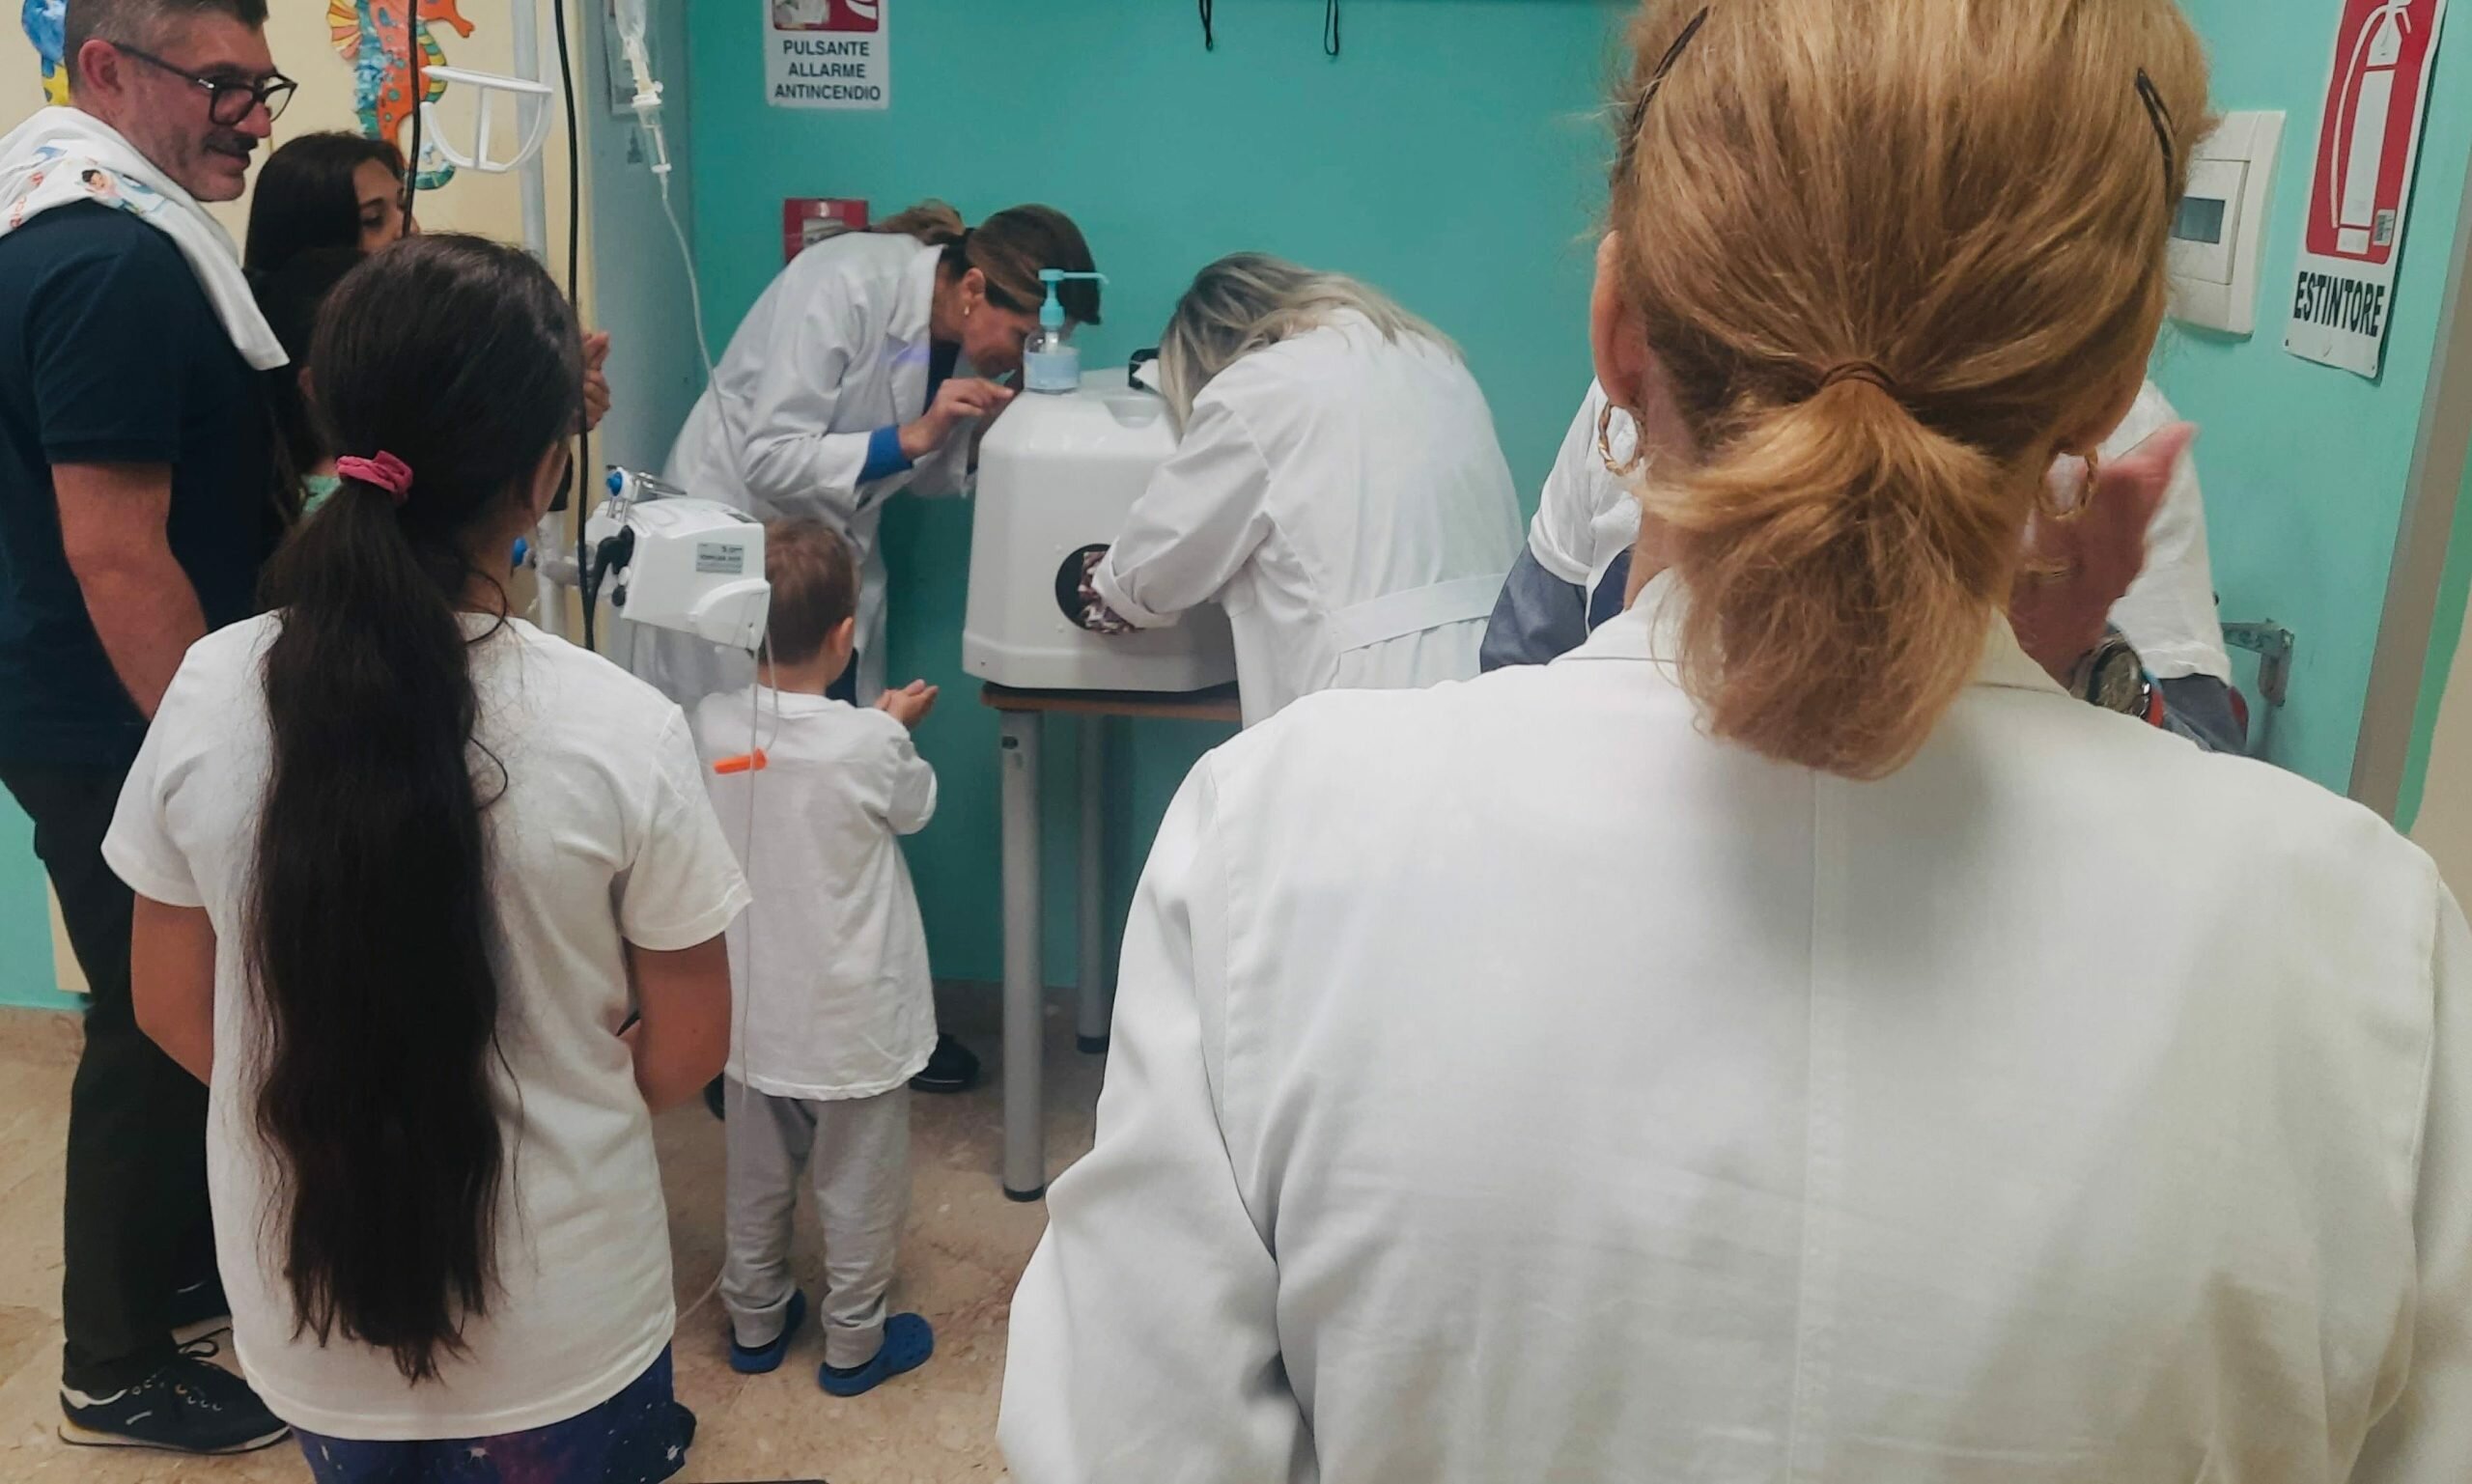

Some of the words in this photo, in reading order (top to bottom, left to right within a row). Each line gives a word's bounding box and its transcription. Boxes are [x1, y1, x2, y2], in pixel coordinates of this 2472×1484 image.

[783, 40, 870, 56] PULSANTE
[788, 62, 866, 78] ALLARME
[774, 83, 881, 100] ANTINCENDIO
[2293, 270, 2385, 338] ESTINTORE
